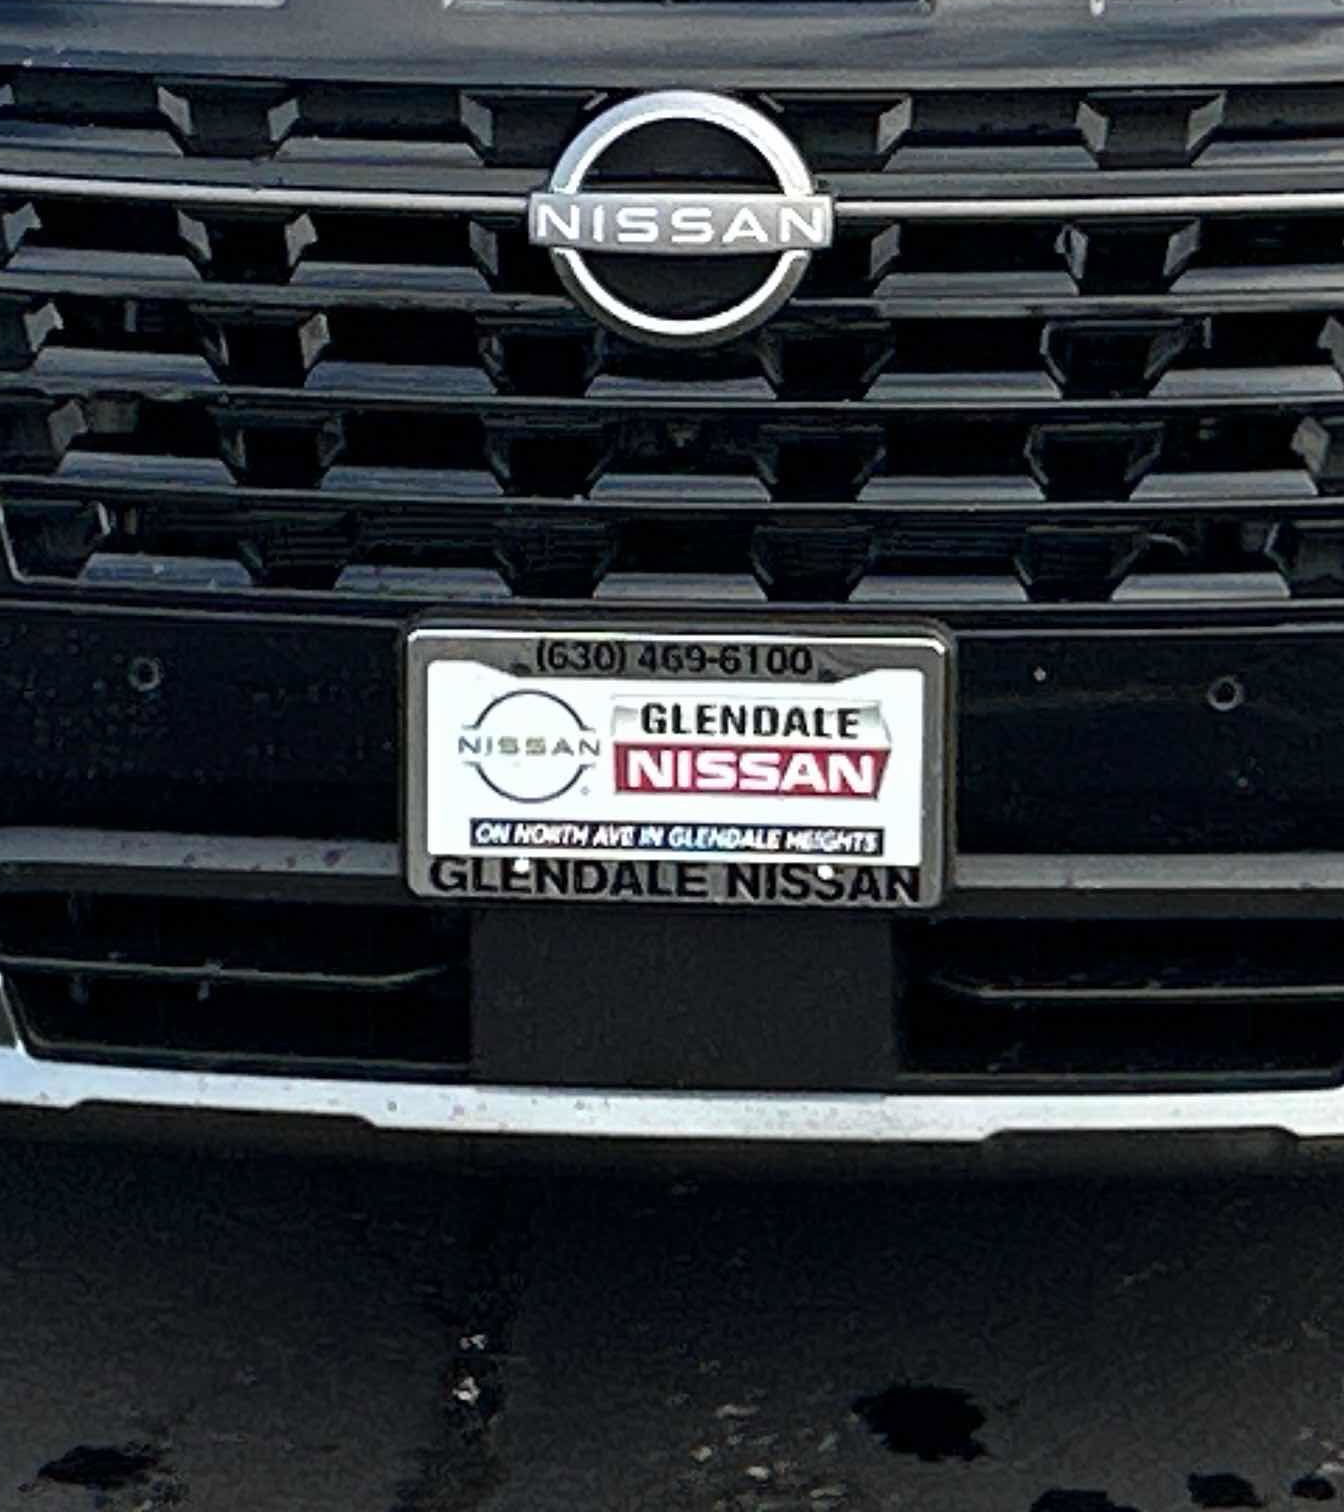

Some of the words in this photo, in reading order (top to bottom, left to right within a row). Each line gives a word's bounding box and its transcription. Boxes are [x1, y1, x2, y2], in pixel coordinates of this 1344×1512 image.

[536, 204, 824, 244] NISSAN
[537, 638, 627, 673] (630)
[637, 641, 813, 675] 469-6100
[640, 702, 861, 739] GLENDALE
[458, 735, 601, 757] NISSAN
[626, 748, 875, 794] NISSAN
[474, 822, 511, 844] ON
[513, 823, 590, 847] NORTH
[592, 824, 635, 847] AVE
[637, 825, 665, 847] IN
[668, 826, 783, 851] GLENDALE
[785, 829, 879, 853] HEIGHTS
[429, 855, 709, 896] GLENDALE
[727, 862, 921, 901] NISSAN
